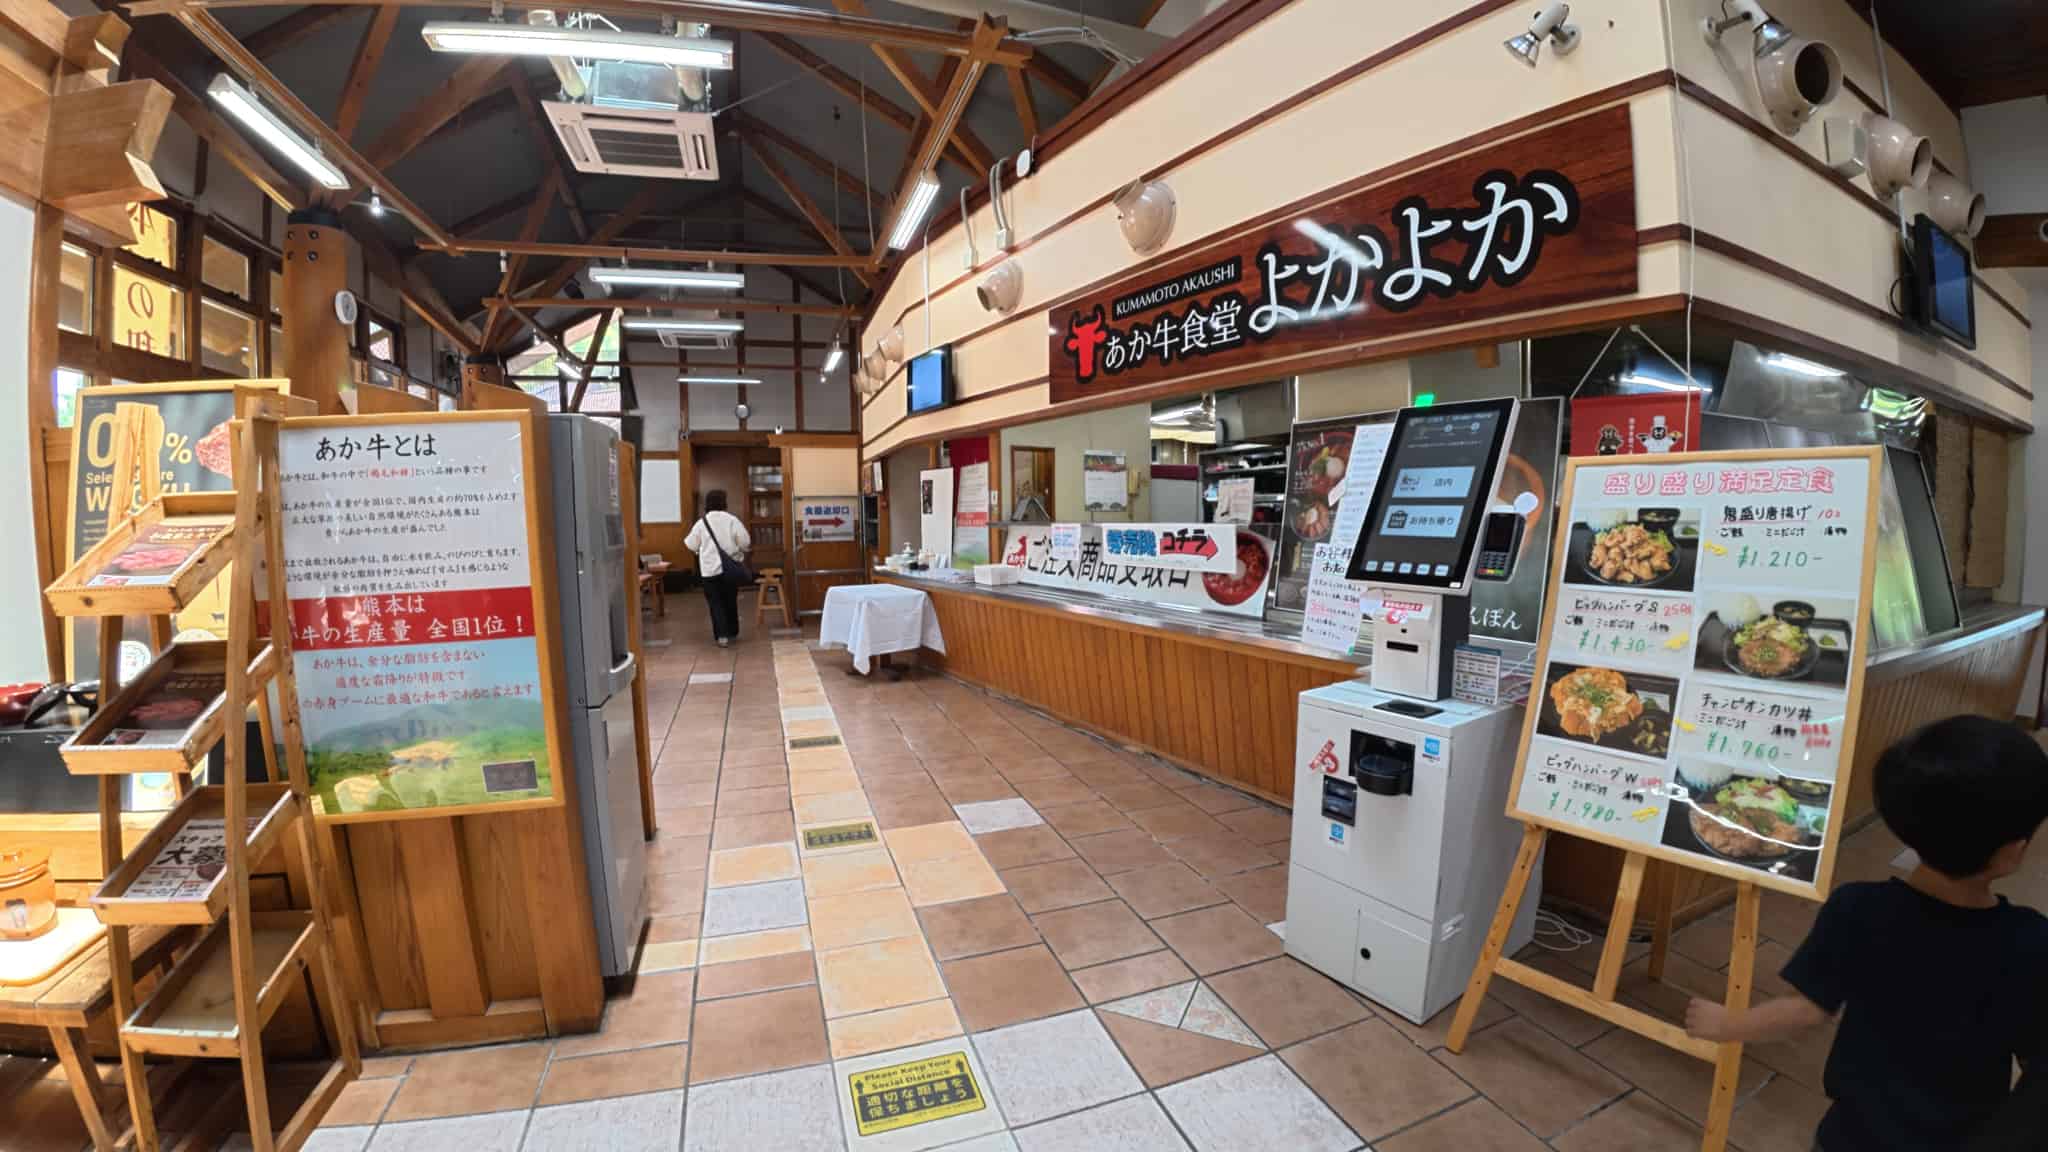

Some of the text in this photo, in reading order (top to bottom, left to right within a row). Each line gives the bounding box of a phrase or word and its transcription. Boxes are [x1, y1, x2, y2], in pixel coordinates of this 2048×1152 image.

[1249, 180, 1568, 333] よかよか
[1115, 263, 1236, 316] KUMAMOTO AKAUSHI
[1105, 300, 1241, 369] あか牛食堂
[316, 433, 438, 461] あか牛とは
[1602, 465, 1835, 497] 盛り盛り満足定食
[1162, 527, 1208, 553] コチラ
[864, 1058, 951, 1081] Please Keep Your
[871, 1069, 951, 1090] Social Distance
